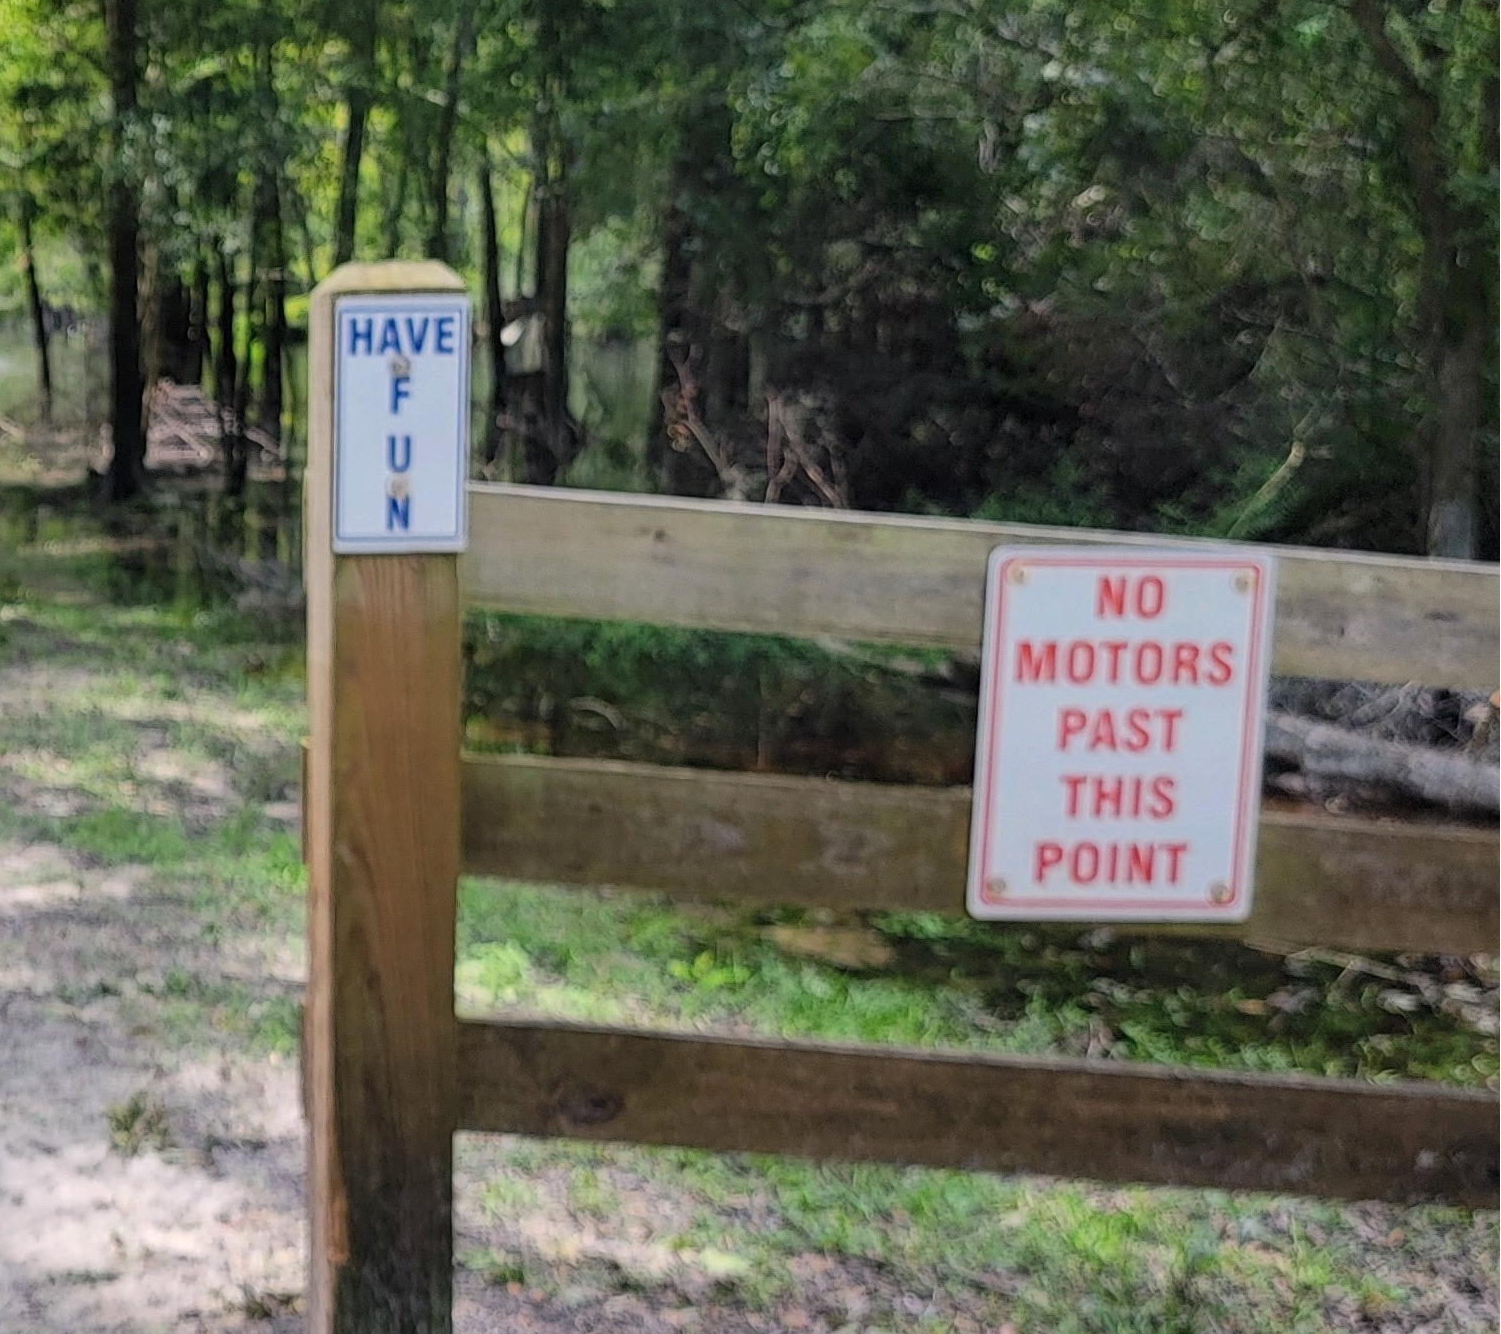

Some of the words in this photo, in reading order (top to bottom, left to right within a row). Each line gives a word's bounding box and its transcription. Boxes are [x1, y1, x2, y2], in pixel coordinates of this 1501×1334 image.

[350, 318, 454, 355] HAVE
[387, 377, 411, 530] FUN
[1098, 576, 1164, 618] NO
[1016, 641, 1234, 684] MOTORS
[1057, 708, 1183, 751] PAST
[1063, 775, 1176, 818] THIS
[1035, 842, 1187, 883] POINT
